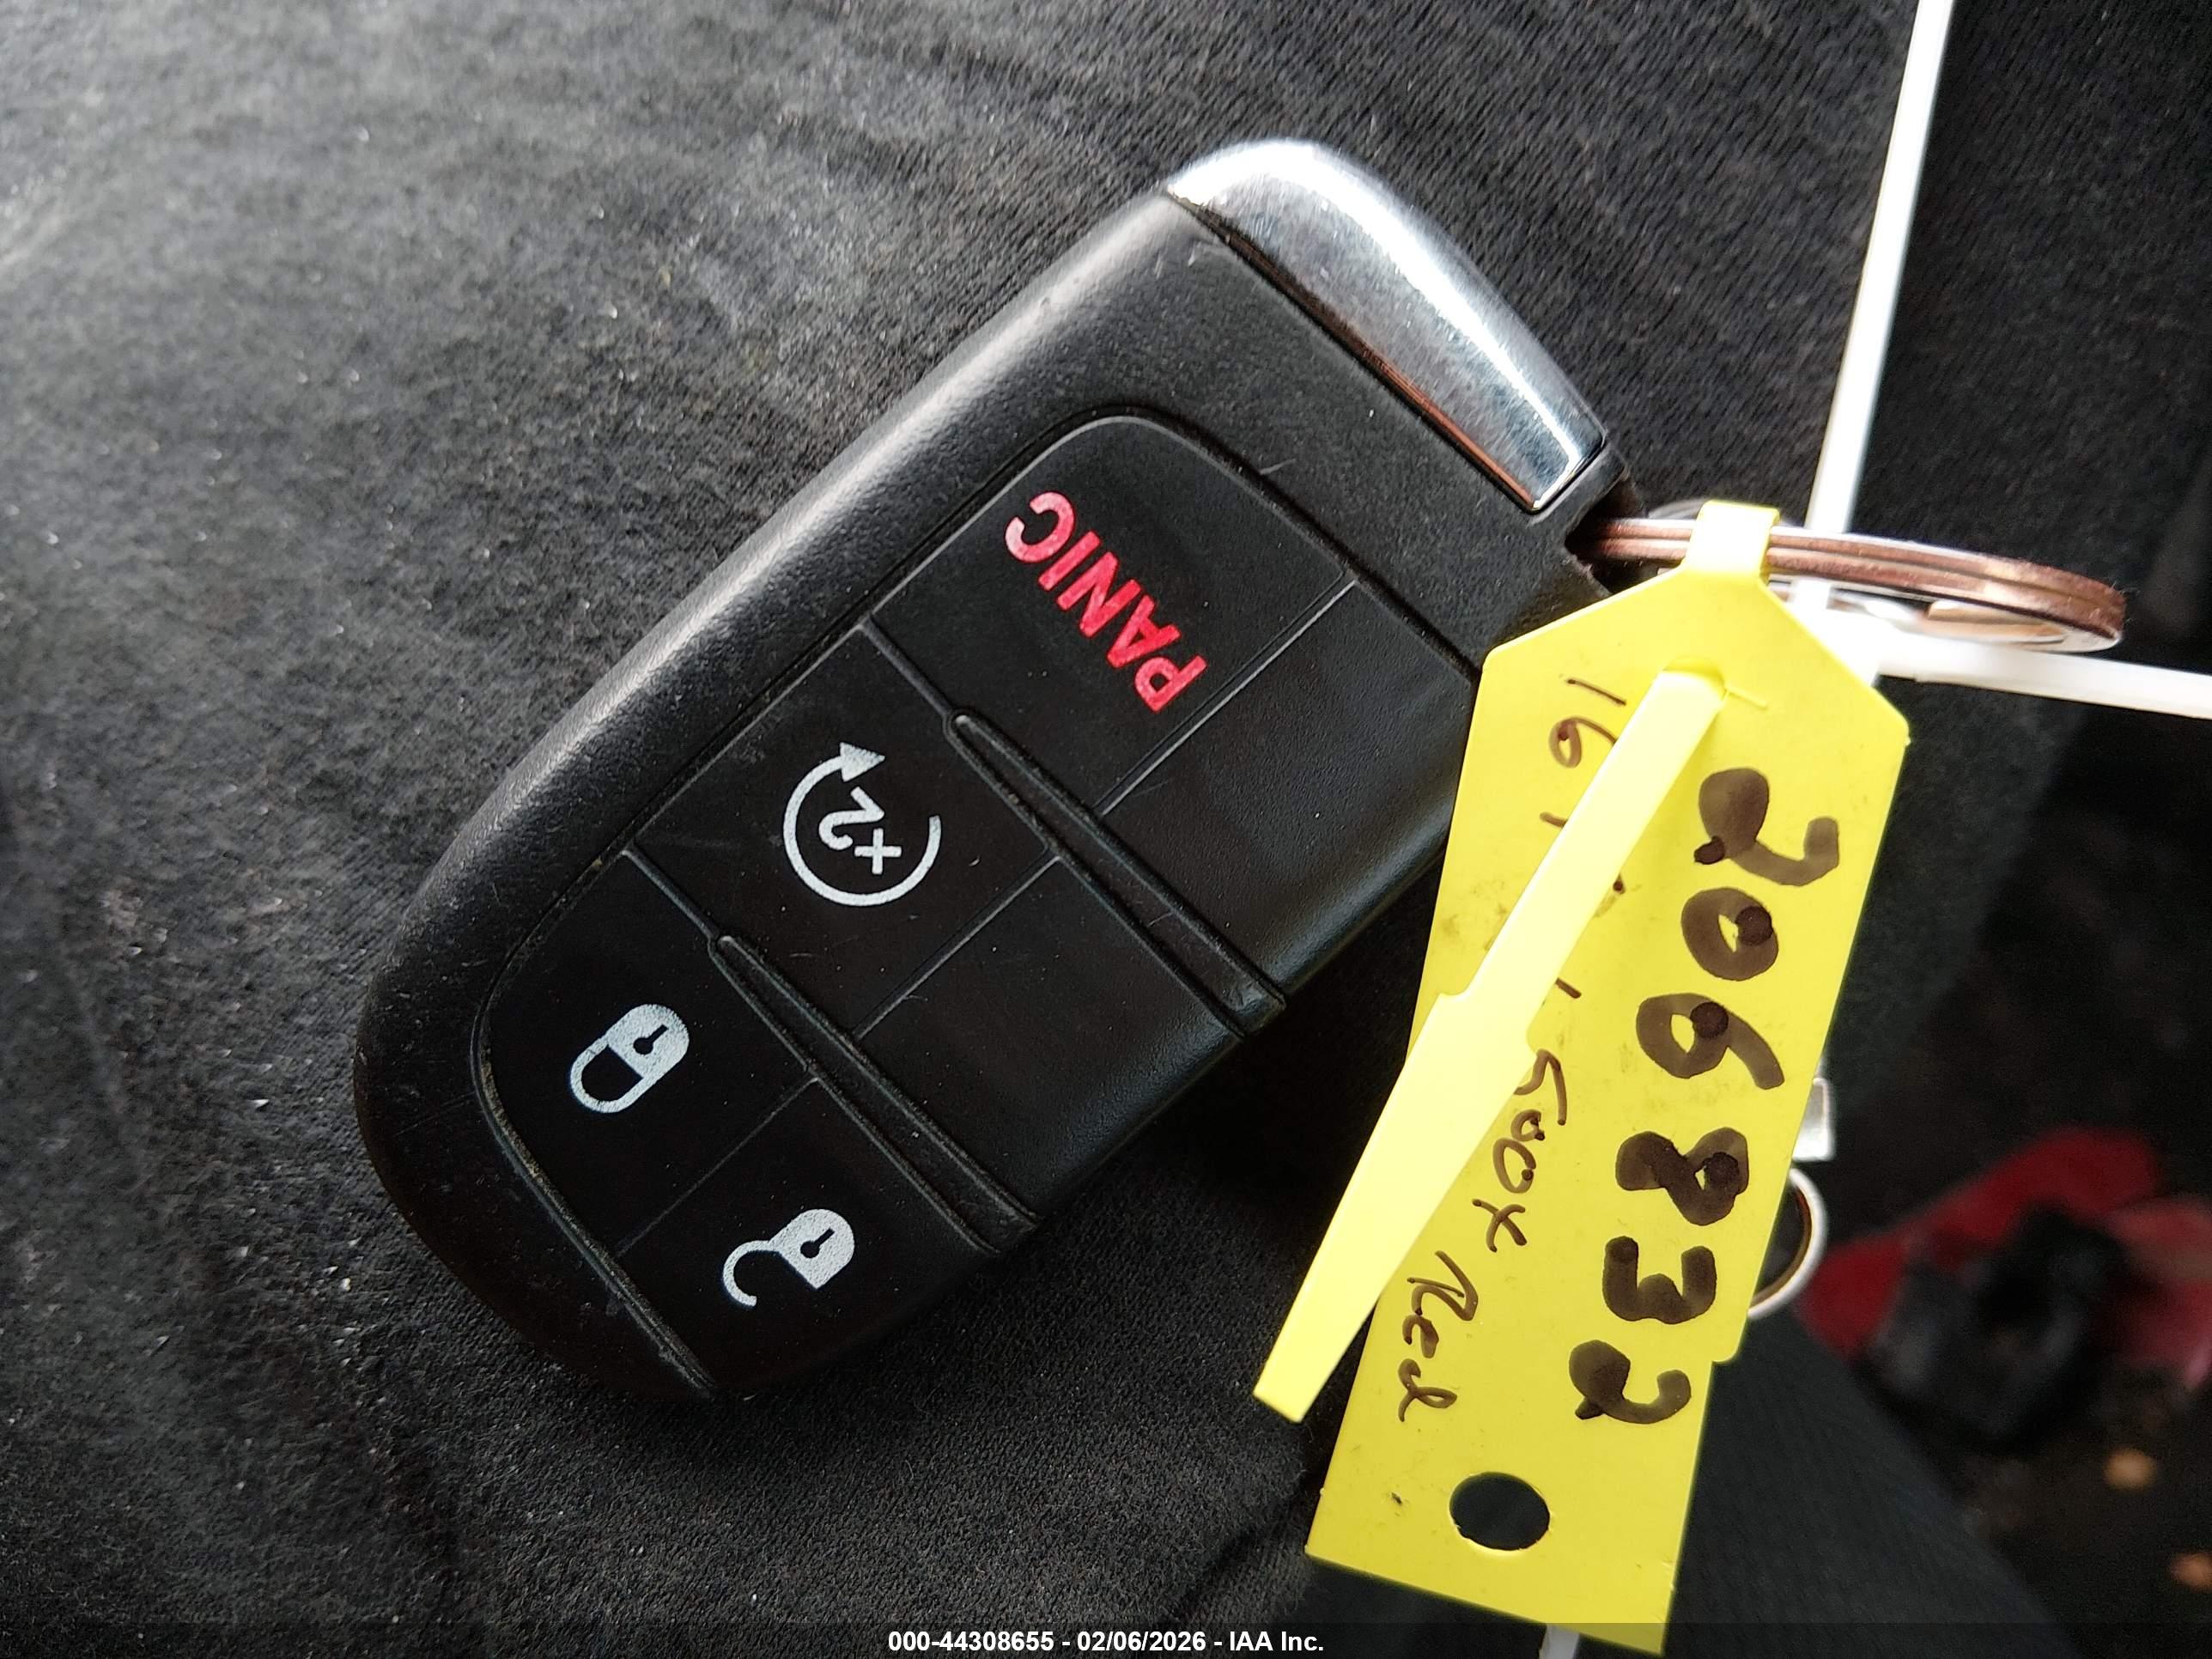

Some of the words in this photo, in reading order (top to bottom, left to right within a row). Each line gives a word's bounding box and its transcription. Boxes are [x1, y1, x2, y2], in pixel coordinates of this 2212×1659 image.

[1005, 490, 1207, 713] PANIC
[1547, 678, 1627, 769] 16
[1568, 767, 1840, 1425] 206832
[1397, 1249, 1479, 1424] Red
